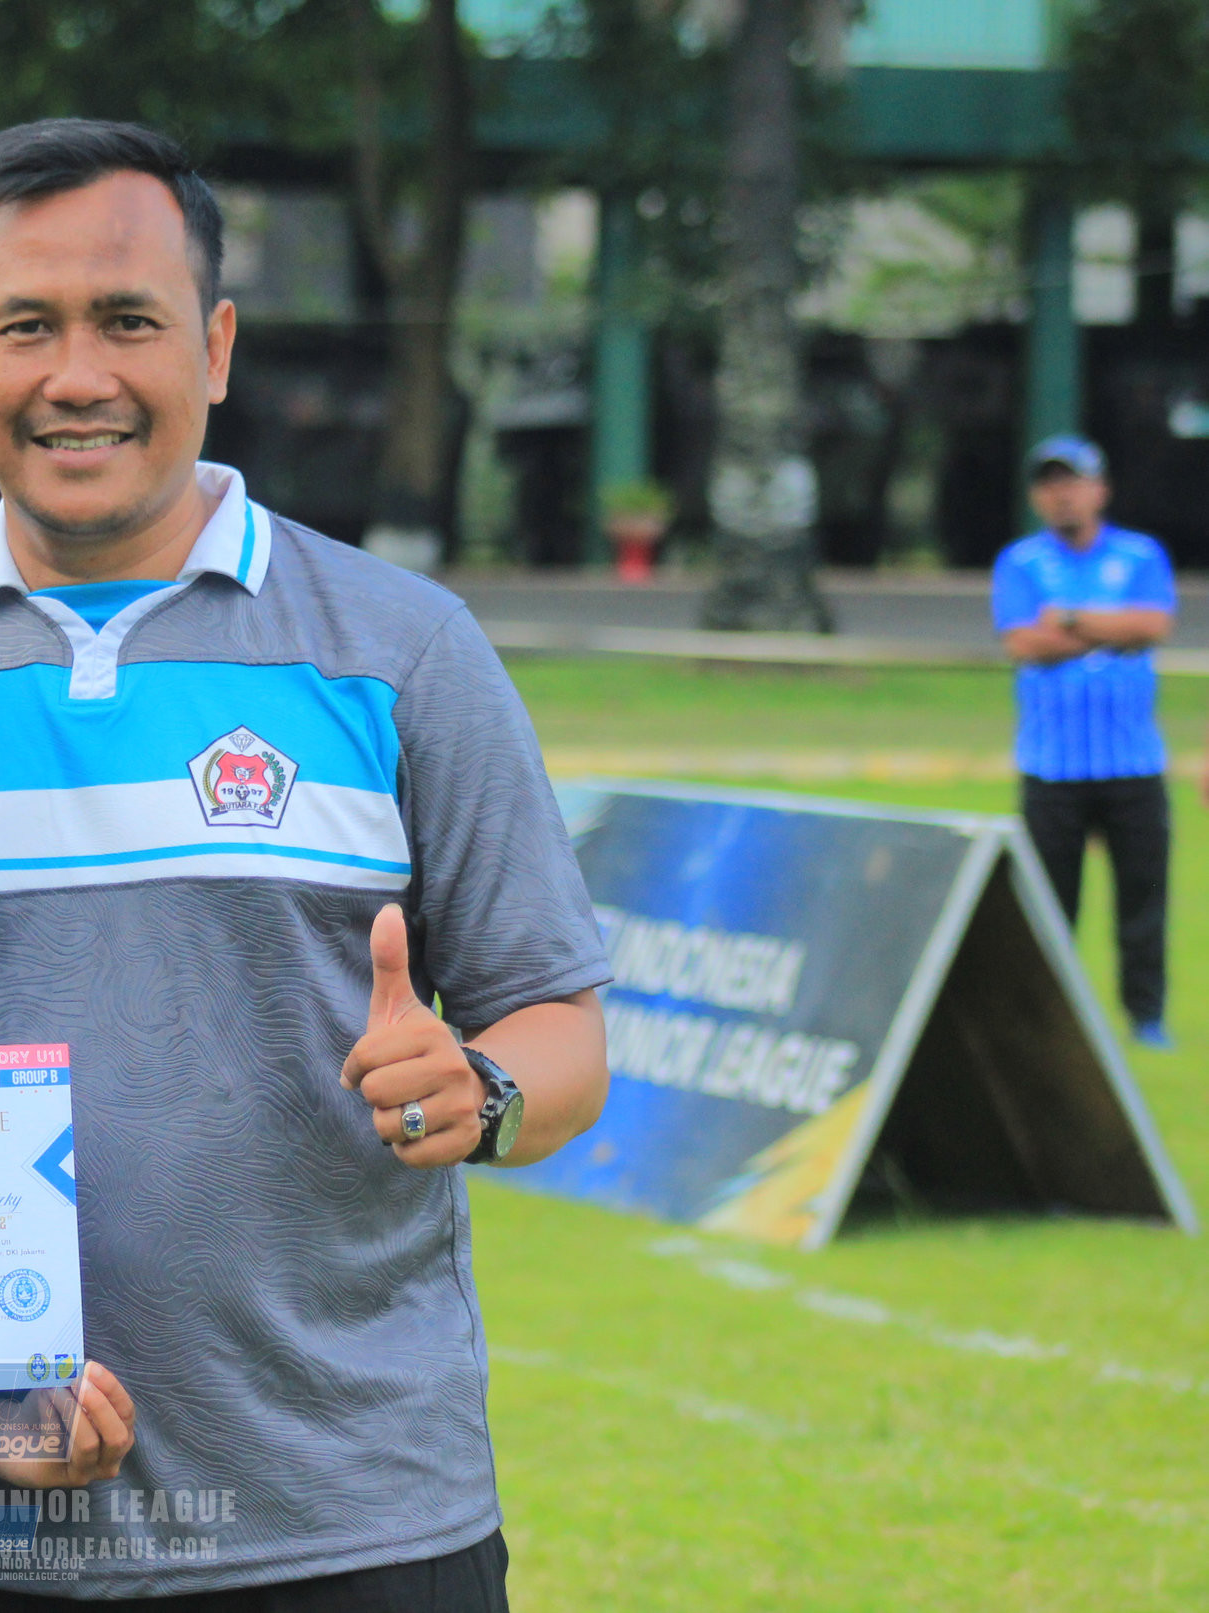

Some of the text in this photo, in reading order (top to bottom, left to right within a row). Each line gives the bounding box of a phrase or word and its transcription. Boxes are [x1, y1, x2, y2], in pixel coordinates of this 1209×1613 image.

[219, 800, 252, 812] MUTIARA
[37, 1049, 63, 1063] U11
[604, 1002, 861, 1116] UNIOR LEAGUE
[12, 1069, 58, 1085] GROUP B
